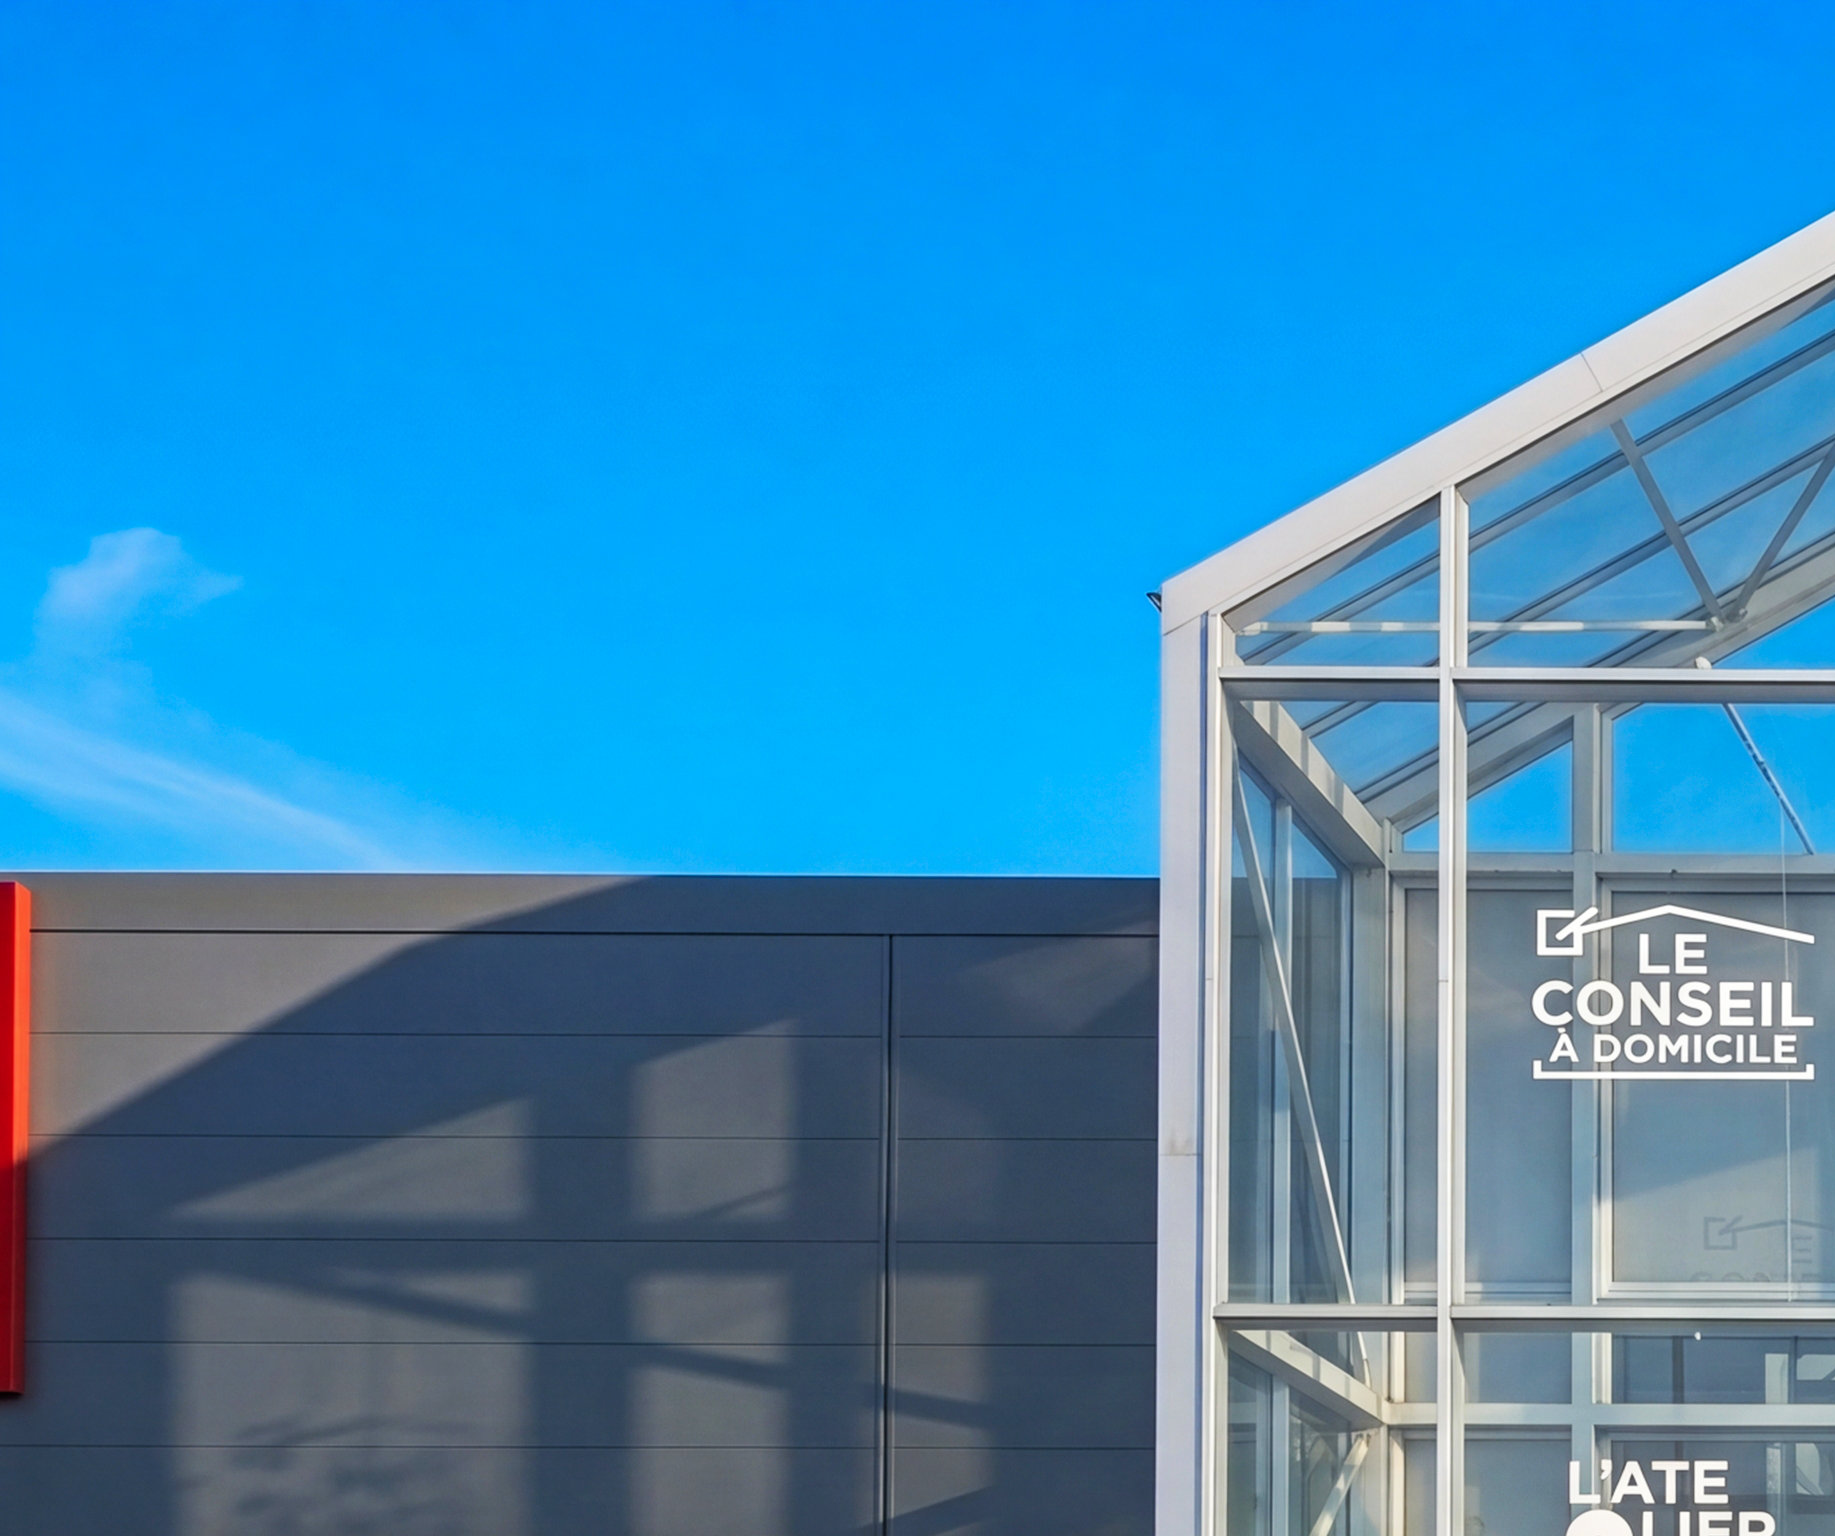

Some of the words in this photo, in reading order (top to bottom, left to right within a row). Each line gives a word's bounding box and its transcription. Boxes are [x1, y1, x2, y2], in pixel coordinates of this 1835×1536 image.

[1637, 932, 1708, 975] LE
[1530, 979, 1816, 1027] CONSEIL
[1548, 1026, 1581, 1064] À
[1592, 1032, 1799, 1065] DOMICILE
